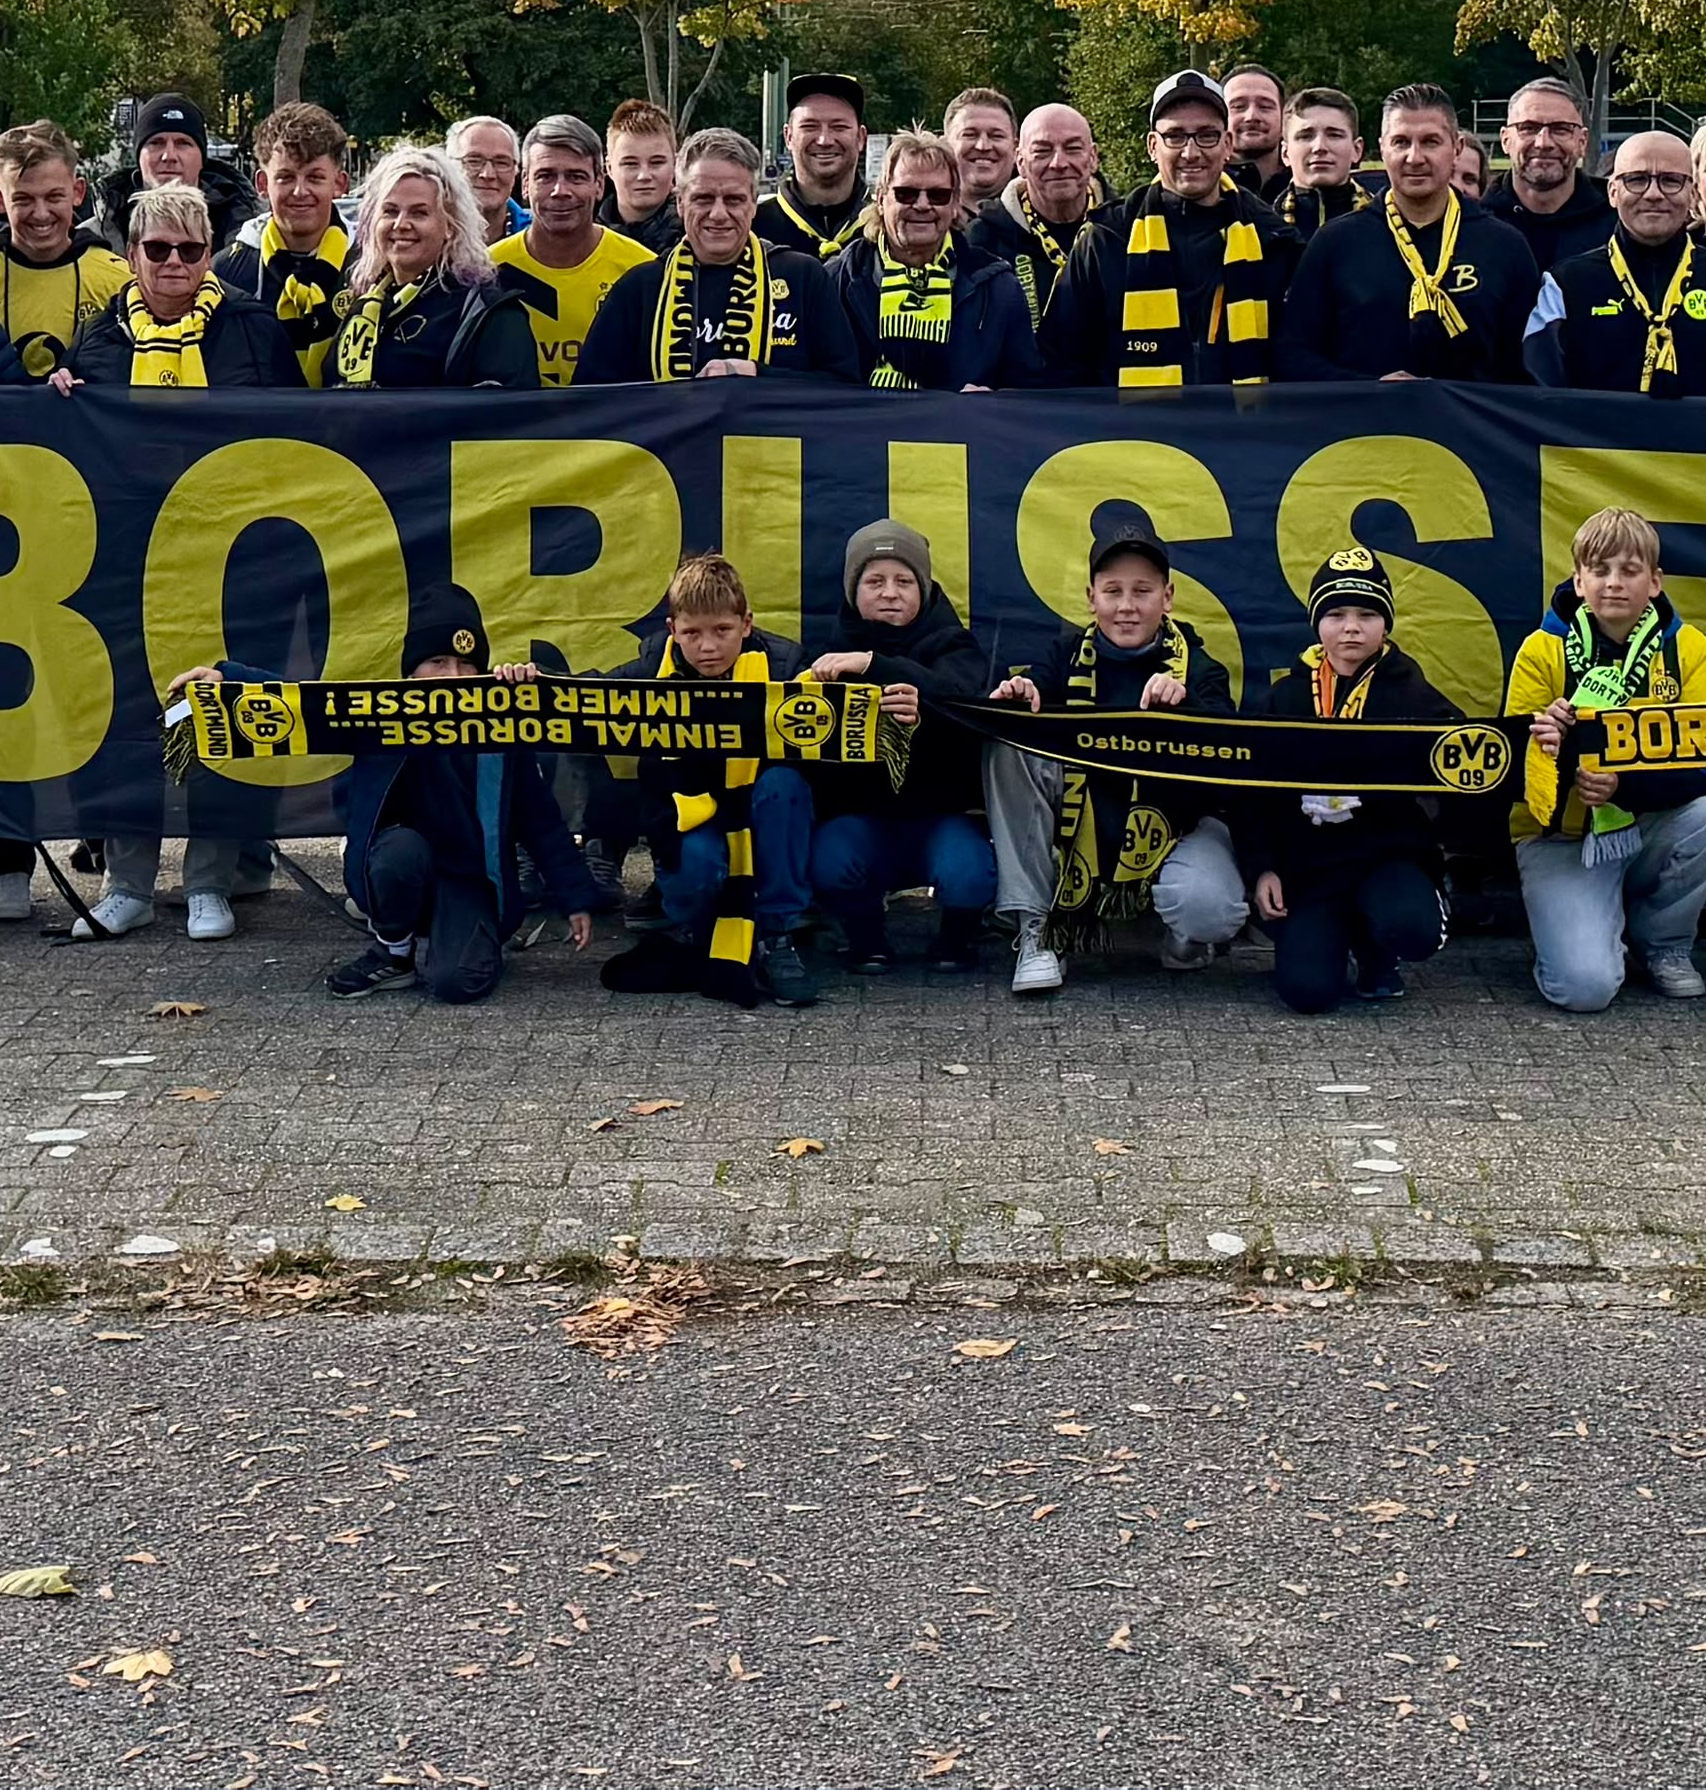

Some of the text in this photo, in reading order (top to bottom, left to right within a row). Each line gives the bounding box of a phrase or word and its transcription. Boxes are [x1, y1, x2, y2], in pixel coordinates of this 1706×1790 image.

[1126, 341, 1158, 352] 1909
[1335, 550, 1370, 567] BVB
[456, 631, 473, 648] BVB
[1655, 680, 1677, 696] BVB
[195, 683, 229, 757] DORTMUND
[248, 700, 286, 737] BVB
[784, 700, 817, 738] BVB
[845, 687, 872, 761] BORUSSIA
[583, 720, 742, 748] EINMAL
[1077, 732, 1251, 760] Ostborussen
[1443, 733, 1502, 770] BVB
[1459, 769, 1485, 786] 09
[1122, 813, 1162, 852] BVB
